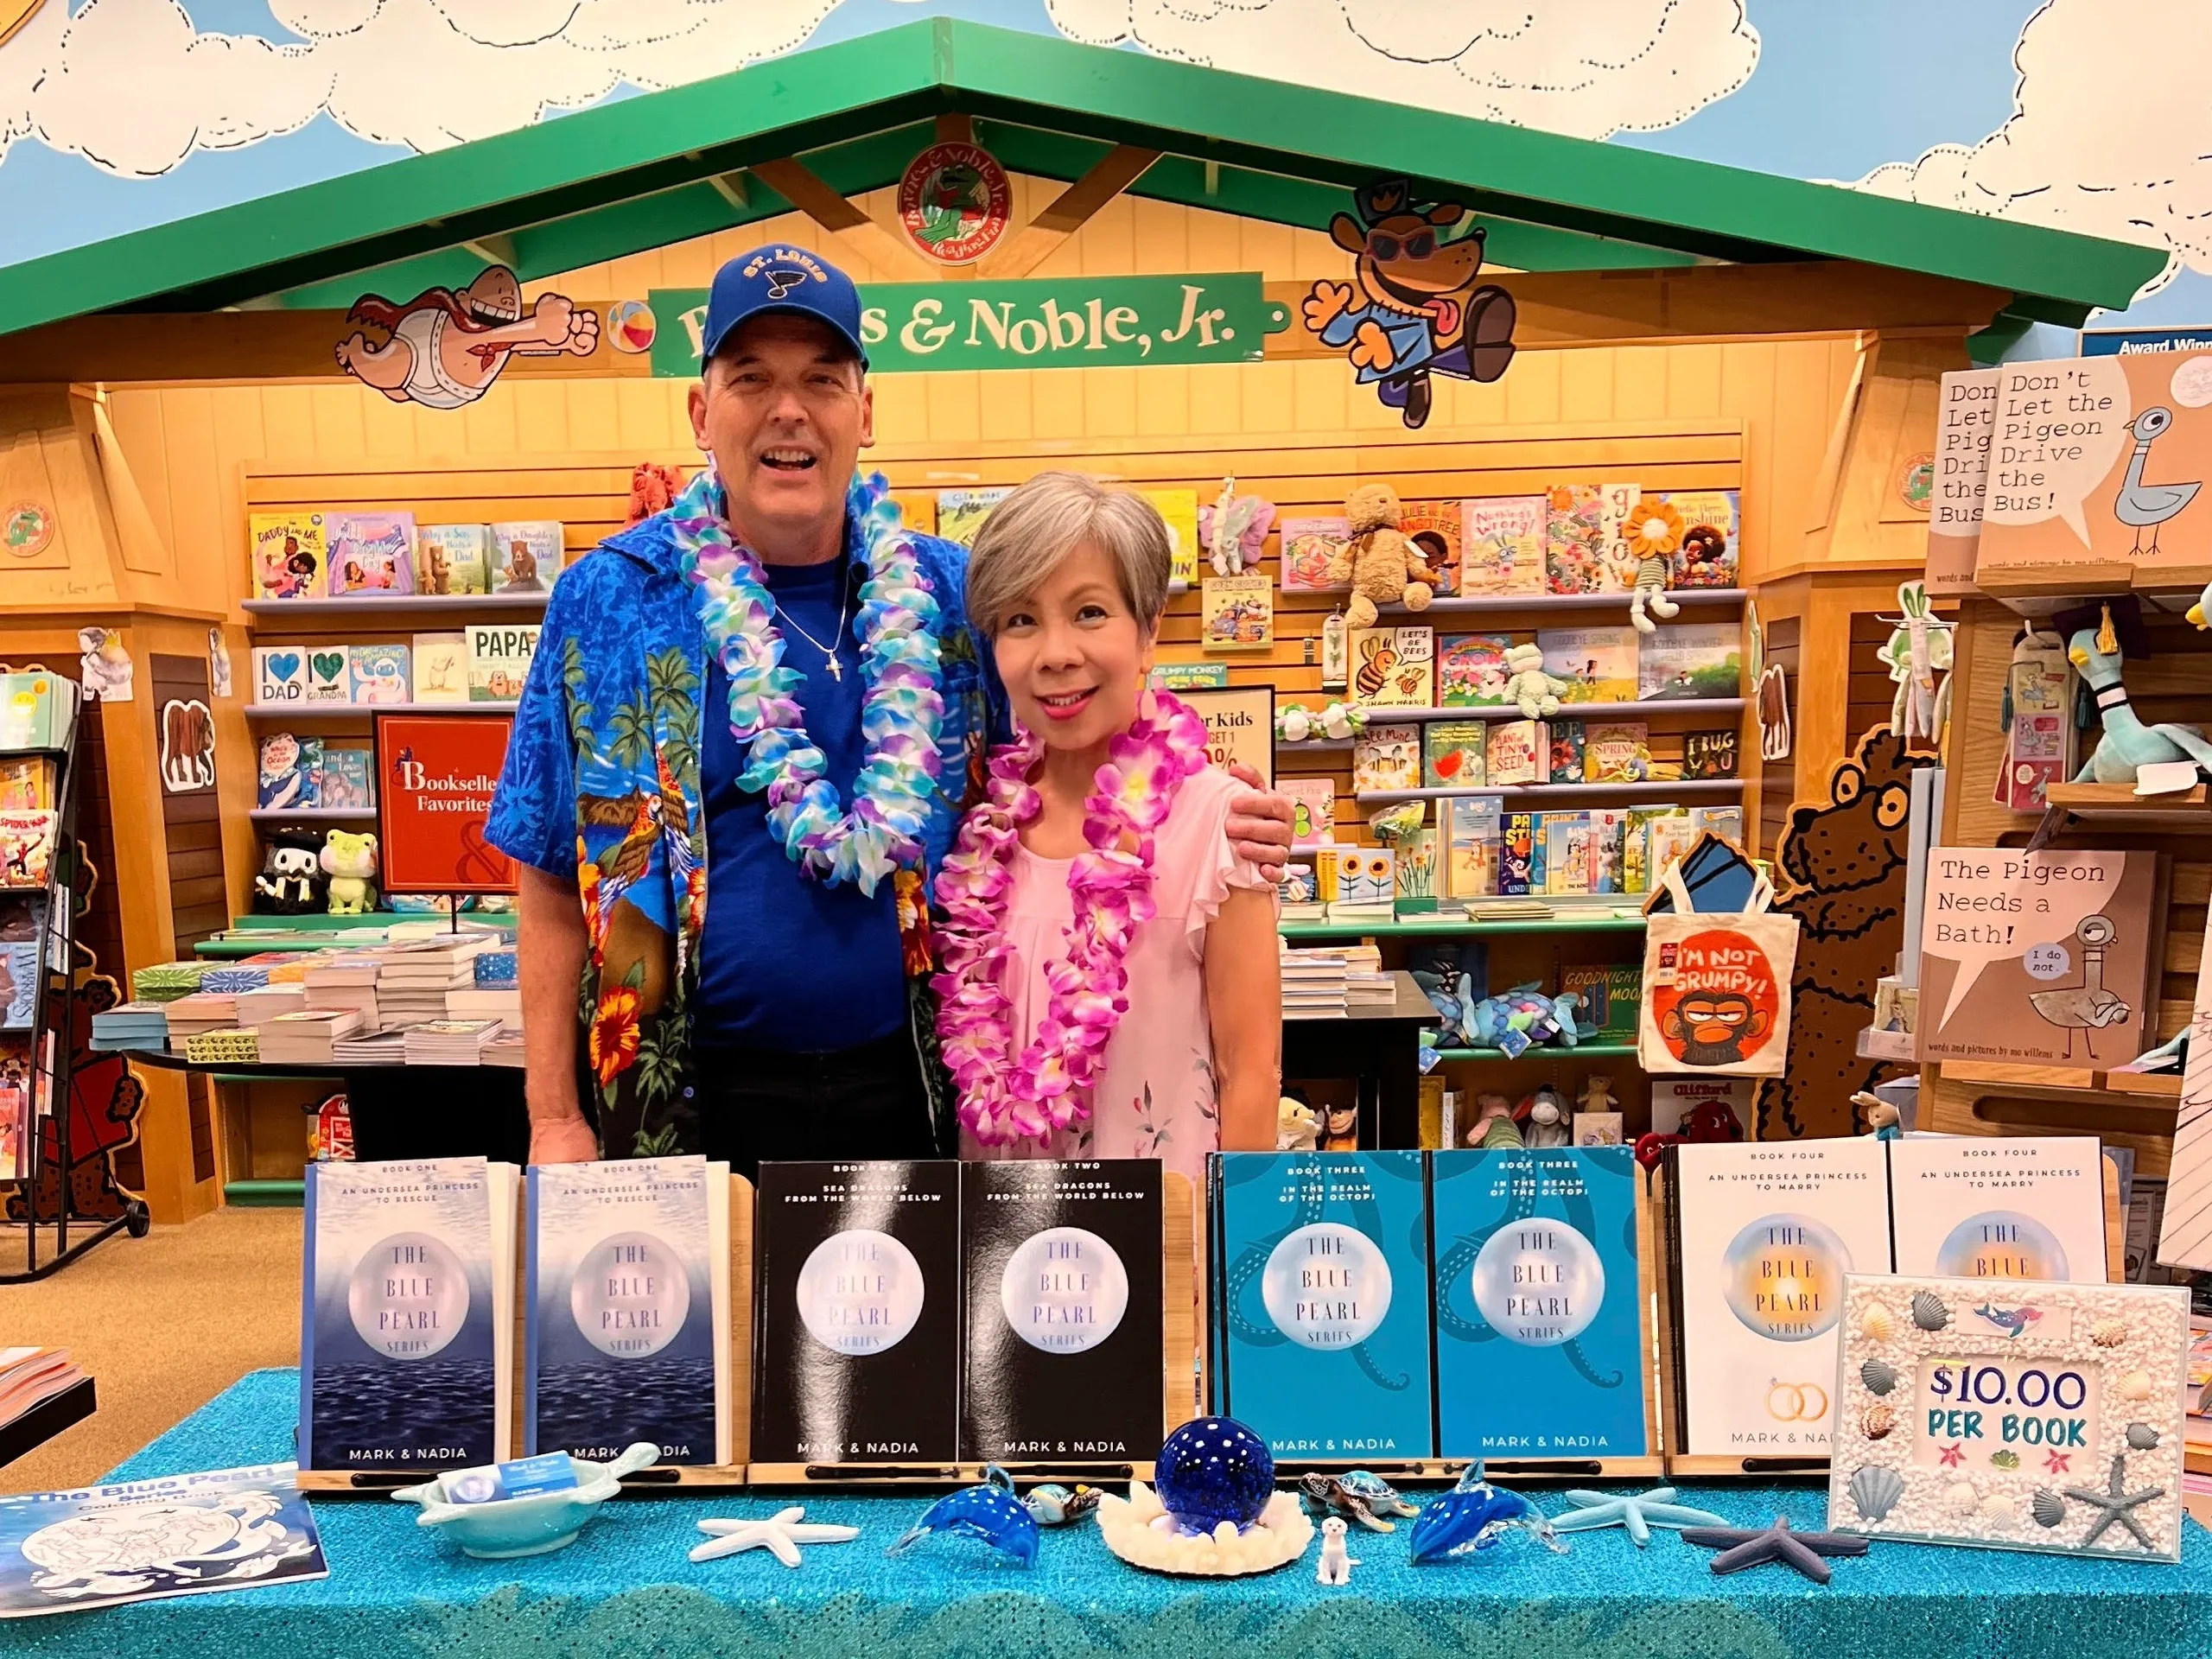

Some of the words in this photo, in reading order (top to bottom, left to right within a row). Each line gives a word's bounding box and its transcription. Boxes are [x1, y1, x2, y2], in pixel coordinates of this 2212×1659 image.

[743, 256, 772, 277] ST.
[775, 249, 828, 283] LOUIS
[899, 299, 956, 353] &
[964, 297, 1153, 357] Noble,
[1160, 284, 1236, 347] Jr.
[2118, 339, 2169, 356] Award
[2174, 338, 2212, 354] Winn
[2010, 371, 2091, 391] Don't
[1949, 385, 1997, 403] Don
[2005, 398, 2052, 416] Let
[2069, 393, 2113, 411] the
[1947, 409, 1992, 427] Let
[2004, 420, 2103, 442] Pigeon
[1945, 431, 1993, 452] Pig
[2000, 443, 2082, 464] Drive
[1943, 454, 1987, 474] Dri
[1999, 468, 2045, 487] the
[1943, 480, 1986, 499] the
[1993, 493, 2056, 512] Bus!
[1477, 509, 1532, 524] Nothing's
[1939, 506, 1984, 523] Bus
[257, 525, 289, 543] DADDY
[303, 530, 319, 541] ME
[1433, 518, 1461, 536] TREE
[1478, 520, 1535, 537] Wrong!
[454, 550, 474, 562] Dad
[537, 549, 553, 559] Dad
[1402, 630, 1427, 639] LET'S
[476, 632, 531, 657] PAPA
[262, 654, 267, 683] I
[308, 654, 313, 683] I
[1152, 666, 1186, 676] GRUMPY
[1188, 665, 1224, 674] MONKEY
[263, 684, 300, 700] DAD
[308, 691, 346, 701] GRANDPA
[1217, 711, 1253, 727] Kids
[1497, 745, 1524, 756] TINY
[1595, 743, 1637, 755] SPRING
[1701, 733, 1734, 753] BUG
[1497, 755, 1523, 772] SEED
[401, 761, 497, 791] Bookselle
[1941, 861, 1990, 880] The
[2003, 859, 2105, 886] Pigeon
[1937, 892, 2022, 912] Needs
[2036, 898, 2050, 913] a
[1936, 924, 2015, 944] Bath!
[1677, 948, 1704, 969] I'M
[1710, 947, 1762, 967] NOT
[2033, 950, 2039, 959] I
[2047, 950, 2062, 960] do
[2032, 962, 2060, 972] not.
[1565, 970, 1641, 985] GOODNIGHT
[1673, 971, 1768, 1000] GRUMPY!
[1928, 1043, 1949, 1052] words
[1951, 1044, 1965, 1053] and
[1967, 1044, 1997, 1056] pictures
[1999, 1046, 2008, 1056] by
[2010, 1048, 2022, 1058] mo
[2024, 1047, 2054, 1059] willems
[1517, 1232, 1556, 1250] THE
[1766, 1227, 1807, 1245] THE
[1980, 1224, 2020, 1243] THE
[614, 1245, 647, 1263] THE
[1046, 1242, 1083, 1259] THE
[1306, 1236, 1344, 1255] THE
[392, 1246, 426, 1264] THE
[1513, 1265, 1564, 1283] BLUE
[1763, 1260, 1814, 1279] BLUE
[1977, 1257, 2030, 1276] BLUE
[387, 1278, 433, 1297] BLUE
[608, 1277, 655, 1296] BLUE
[1040, 1273, 1090, 1292] BLUE
[1302, 1269, 1352, 1288] BLUE
[1296, 1301, 1361, 1321] PEARL
[1507, 1298, 1573, 1316] PEARL
[1756, 1293, 1823, 1312] PEARL
[379, 1310, 440, 1331] PEARL
[601, 1310, 662, 1329] PEARL
[1033, 1306, 1096, 1324] PEARL
[1307, 1331, 1352, 1343] SERIES
[1519, 1326, 1564, 1338] SERIES
[1768, 1322, 1814, 1335] SERIES
[387, 1340, 429, 1353] SERIES
[610, 1339, 651, 1351] SERIES
[1931, 1363, 2087, 1411] $10.00
[1929, 1408, 1984, 1440] PER
[2002, 1413, 2088, 1448] BOOK
[797, 1443, 844, 1453] MARK
[849, 1443, 860, 1453] &
[867, 1442, 918, 1453] NADIA
[1004, 1441, 1051, 1452] MARK
[1057, 1441, 1067, 1452] &
[1074, 1441, 1126, 1452] NADIA
[1273, 1439, 1319, 1451] MARK
[1326, 1439, 1336, 1450] &
[1343, 1438, 1395, 1450] NADIA
[1482, 1436, 1530, 1447] MARK
[1537, 1436, 1548, 1446] &
[1554, 1435, 1608, 1446] NADIA
[1732, 1433, 1779, 1444] MARK
[1788, 1433, 1798, 1444] &
[349, 1448, 395, 1460] MARK
[401, 1449, 410, 1459] &
[417, 1447, 467, 1459] NADIA
[101, 1481, 177, 1497] Blue
[188, 1467, 275, 1485] Pearl
[118, 1489, 187, 1502] Series
